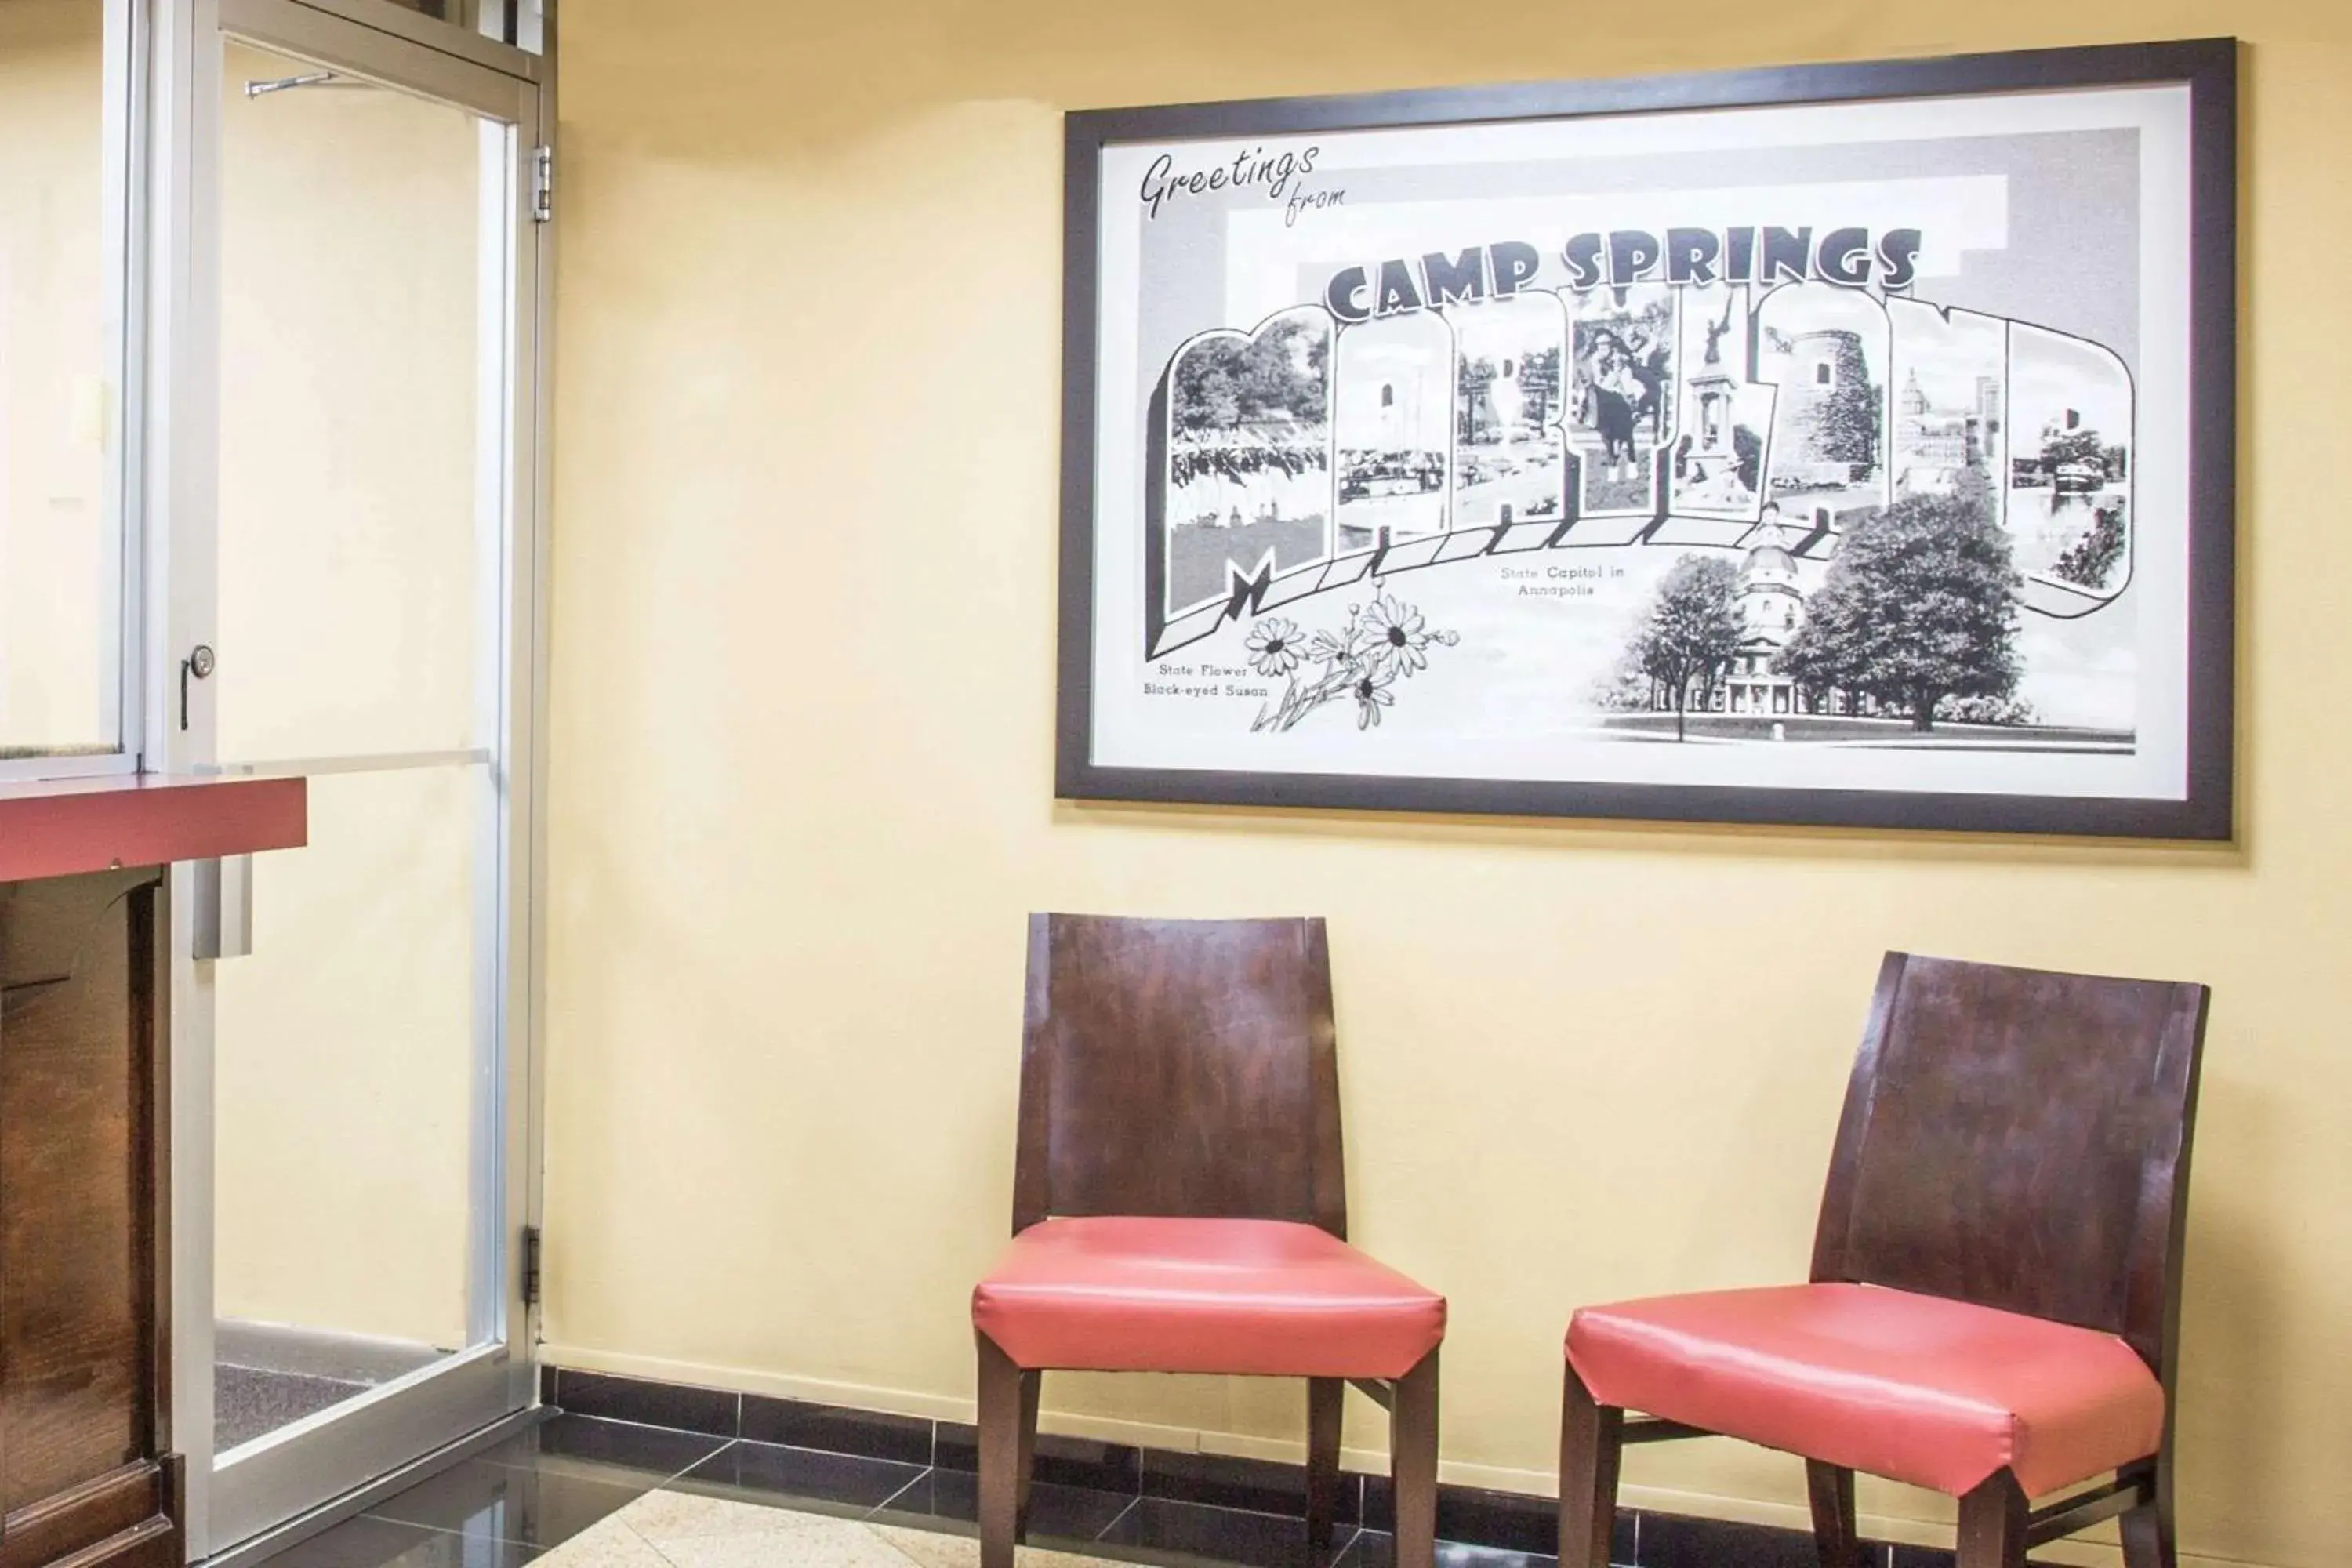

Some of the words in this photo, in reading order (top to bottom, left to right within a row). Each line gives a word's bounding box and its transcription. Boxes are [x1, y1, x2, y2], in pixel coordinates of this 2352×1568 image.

[1141, 146, 1319, 220] Greetings
[1285, 181, 1347, 228] from
[1324, 240, 1541, 323] CAMP
[1563, 226, 1922, 290] SPRINGS
[1501, 567, 1539, 579] State
[1547, 565, 1602, 581] Capitol
[1611, 565, 1624, 578] in
[1518, 584, 1594, 597] Annapolis
[1159, 664, 1194, 676] State
[1200, 664, 1249, 677] Flower
[1143, 683, 1218, 697] Black-eyed
[1225, 684, 1269, 696] Susan
